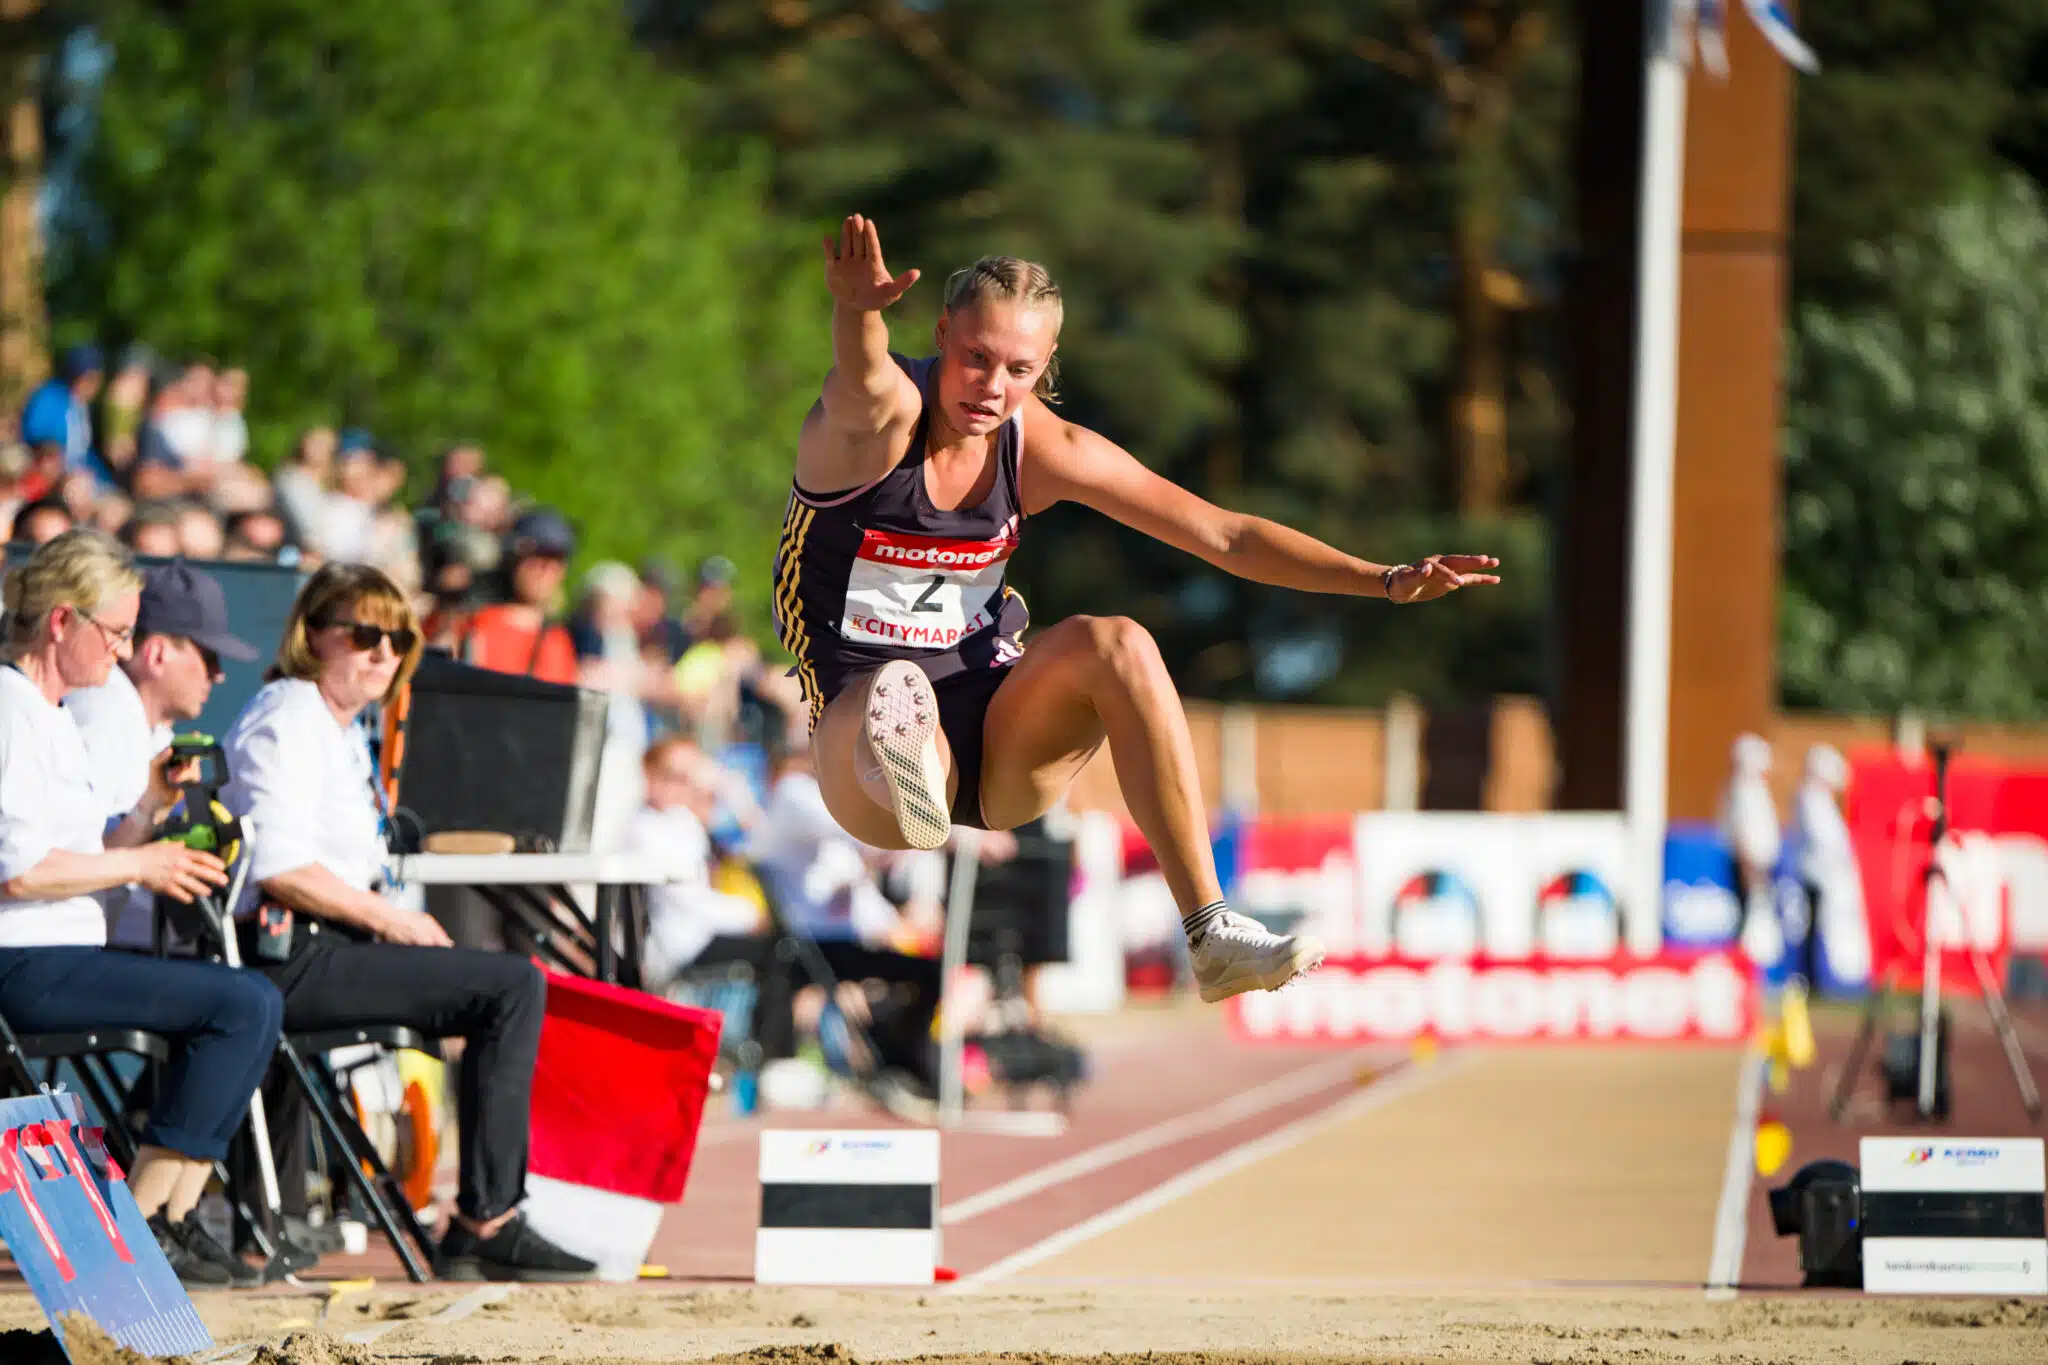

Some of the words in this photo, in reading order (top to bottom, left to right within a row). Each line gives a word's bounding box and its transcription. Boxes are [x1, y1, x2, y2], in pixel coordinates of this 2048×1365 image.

[874, 543, 1004, 566] motonet
[911, 573, 946, 613] 2
[865, 612, 985, 645] CITYMARET
